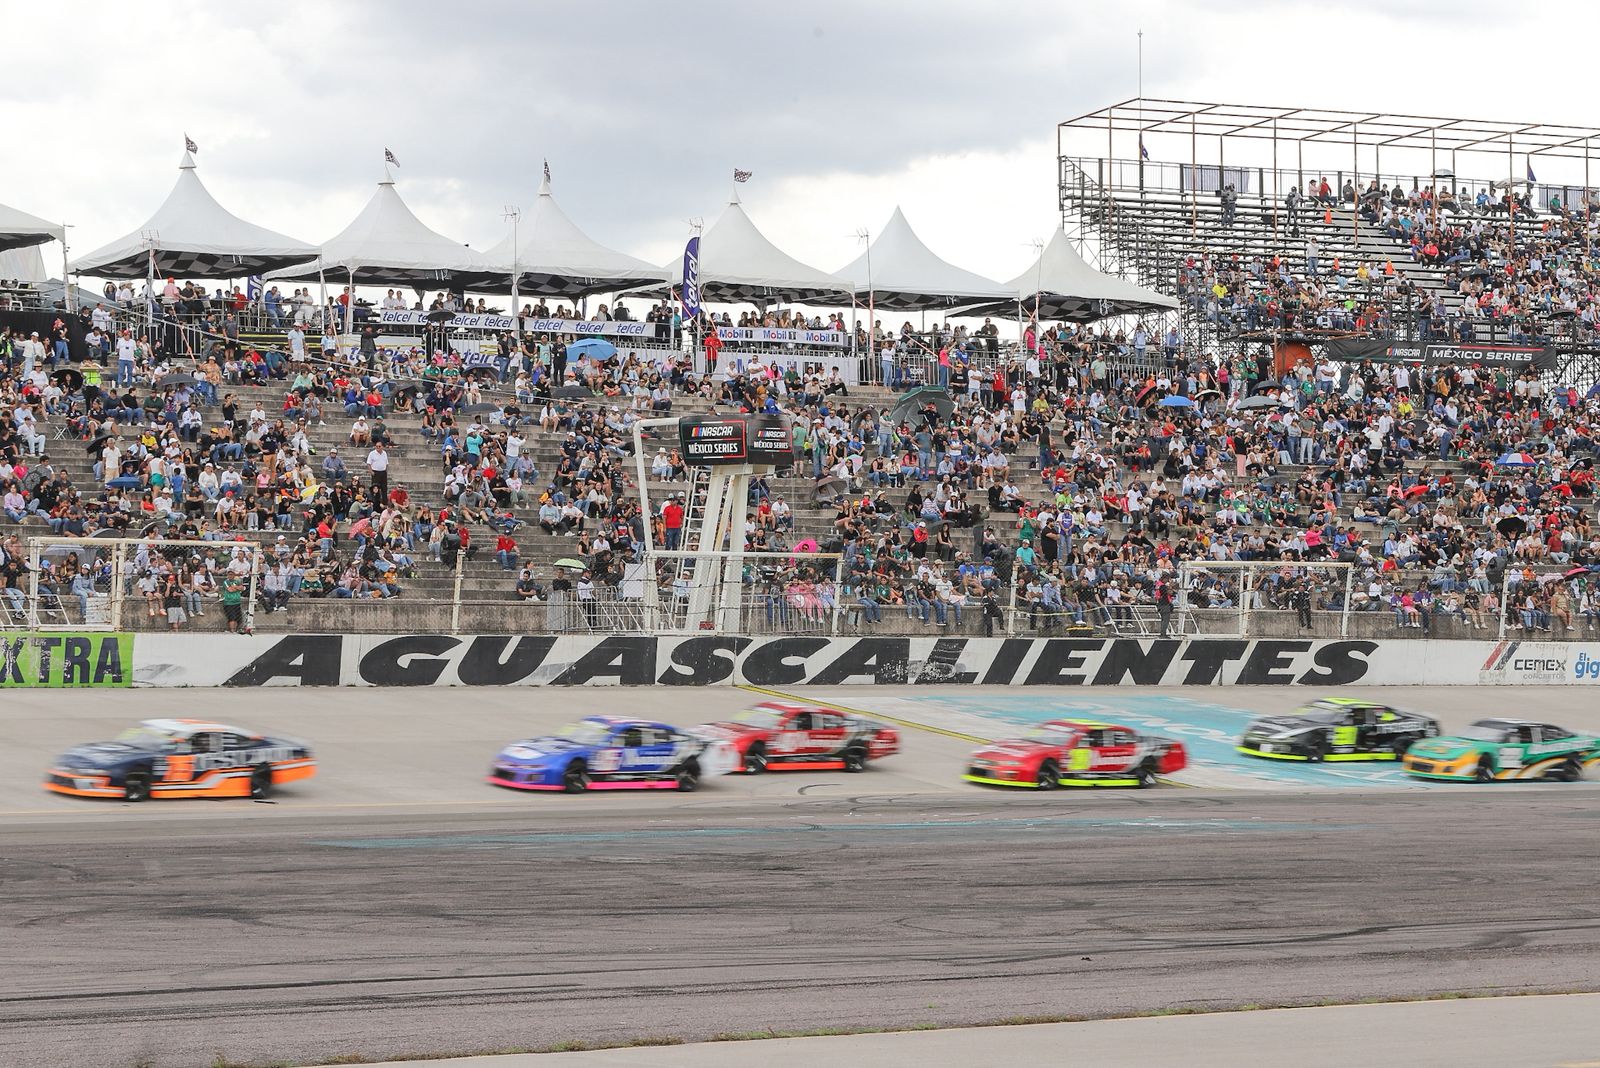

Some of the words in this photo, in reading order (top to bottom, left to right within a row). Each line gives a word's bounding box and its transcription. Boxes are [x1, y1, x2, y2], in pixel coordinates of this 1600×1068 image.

[685, 251, 698, 309] telcel
[383, 311, 412, 323] telcel
[450, 314, 481, 326] telcel
[484, 316, 514, 328] telcel
[533, 320, 564, 331] telcel
[575, 322, 605, 333] telcel
[616, 323, 646, 335] telcel
[719, 329, 744, 339] Mobil
[745, 329, 753, 339] 1
[763, 330, 787, 340] Mobil
[788, 331, 797, 341] 1
[806, 332, 830, 342] Mobil
[831, 333, 840, 343] 1
[1394, 348, 1421, 357] NASCAR
[1432, 348, 1483, 360] MÉXICO
[1485, 351, 1533, 361] SERIES
[701, 426, 733, 437] NASCAR
[688, 442, 713, 454] MÉXICO
[714, 442, 738, 453] SERIES
[753, 440, 773, 449] MÉXICO
[773, 441, 789, 449] SERIES
[0, 637, 122, 683] XTRA
[222, 635, 1378, 687] AGUASCALIENTES
[1514, 659, 1567, 671] CEMEX
